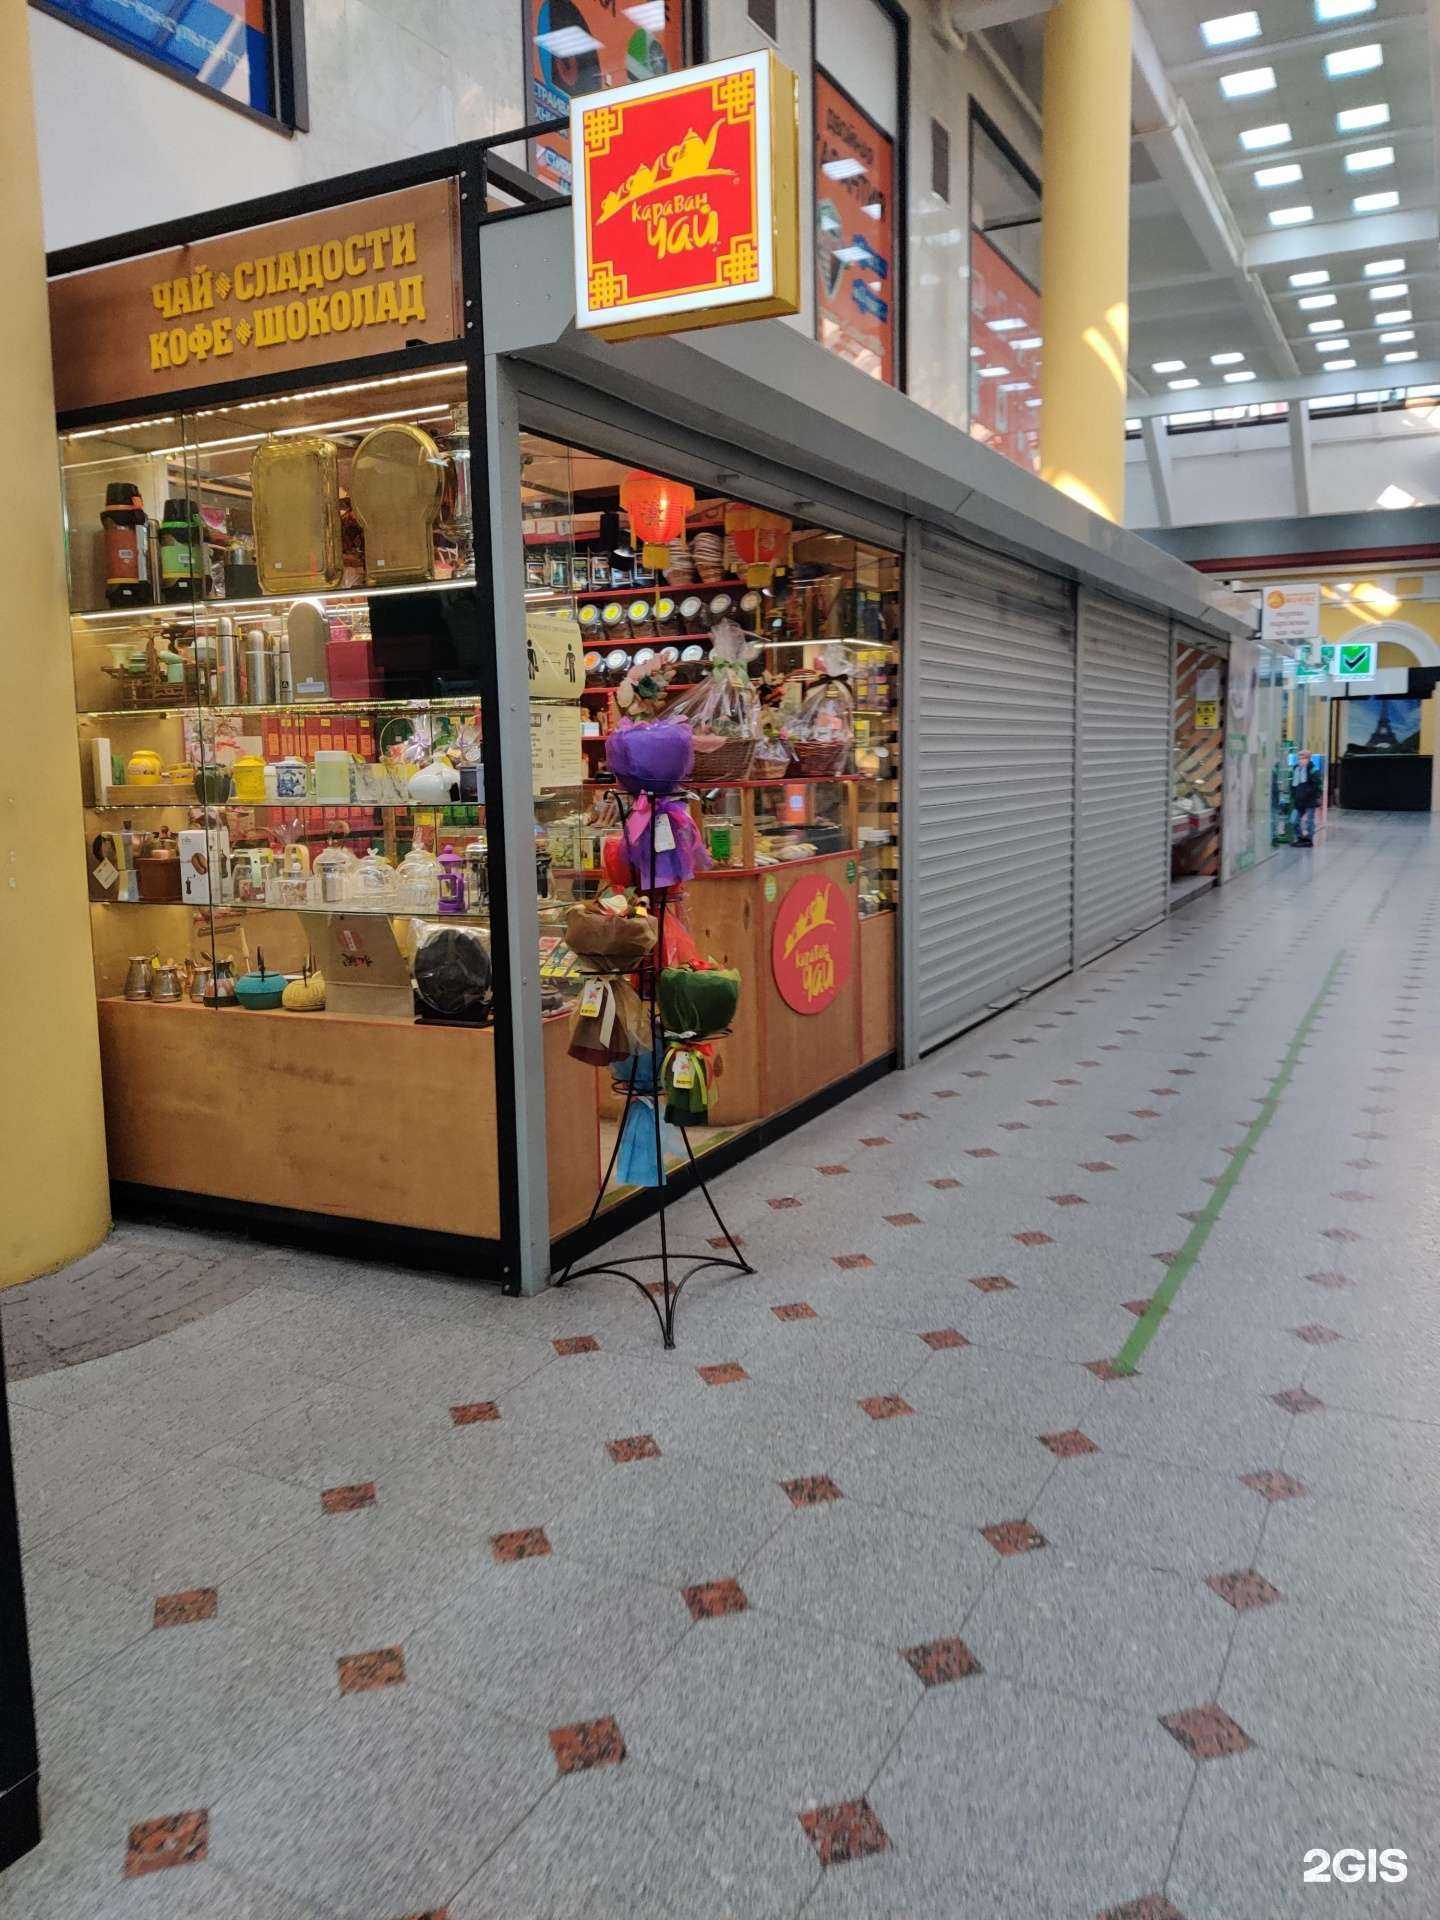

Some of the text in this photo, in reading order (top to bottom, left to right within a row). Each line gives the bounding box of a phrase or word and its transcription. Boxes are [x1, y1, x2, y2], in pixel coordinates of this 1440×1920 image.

[151, 222, 417, 319] ЧАЙ СЛАДОСТИ
[149, 275, 426, 370] КОФЕ ШОКОЛАД
